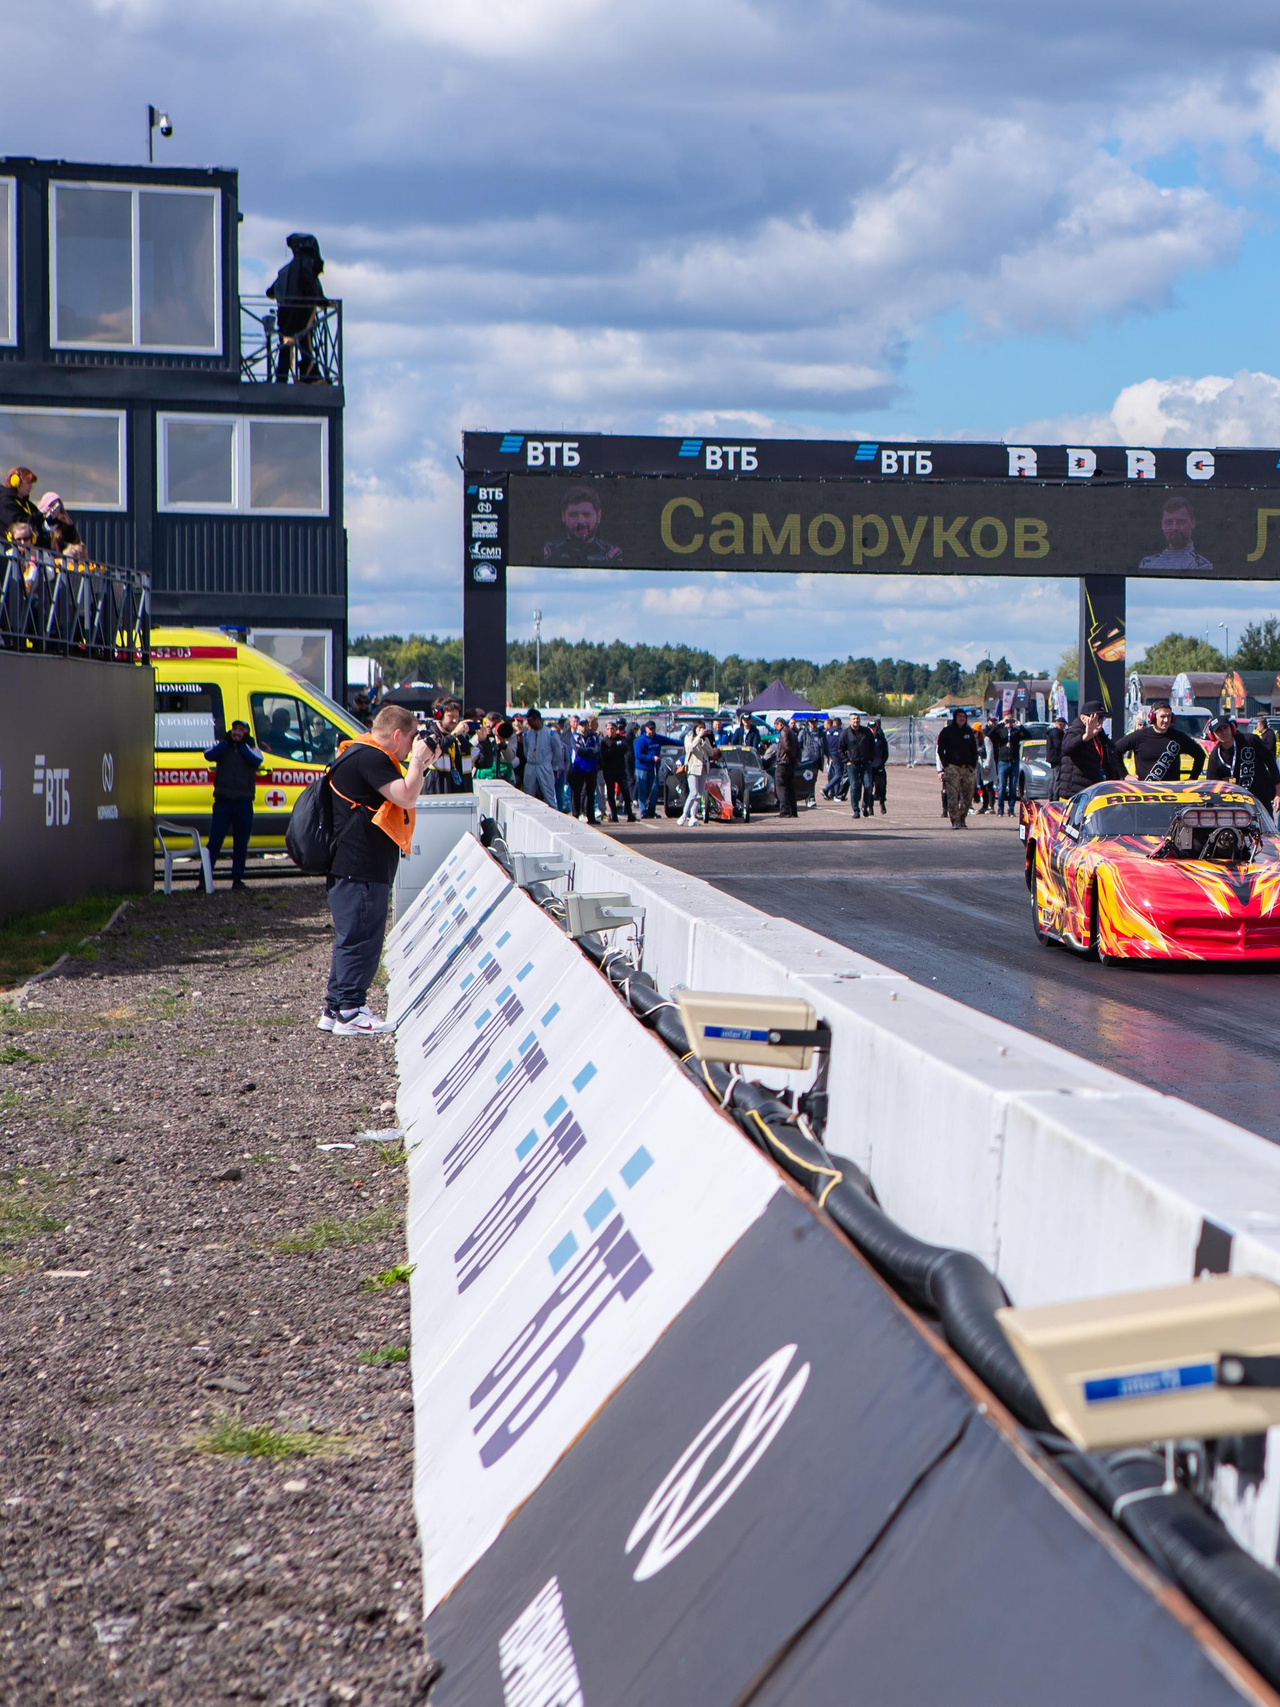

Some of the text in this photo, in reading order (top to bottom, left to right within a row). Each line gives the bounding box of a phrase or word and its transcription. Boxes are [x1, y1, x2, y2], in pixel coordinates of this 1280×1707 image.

[526, 441, 581, 467] ВТБ
[705, 445, 758, 471] ВТБ
[881, 449, 933, 475] ВТБ
[479, 487, 504, 501] ВТБ
[660, 497, 1051, 566] Саморуков
[167, 717, 216, 727] БОЛЬНЫХ
[271, 771, 325, 783] ПОМО
[46, 768, 70, 827] ВТБ
[1106, 793, 1256, 805] RDRC 333
[469, 1211, 655, 1469] ВТБ
